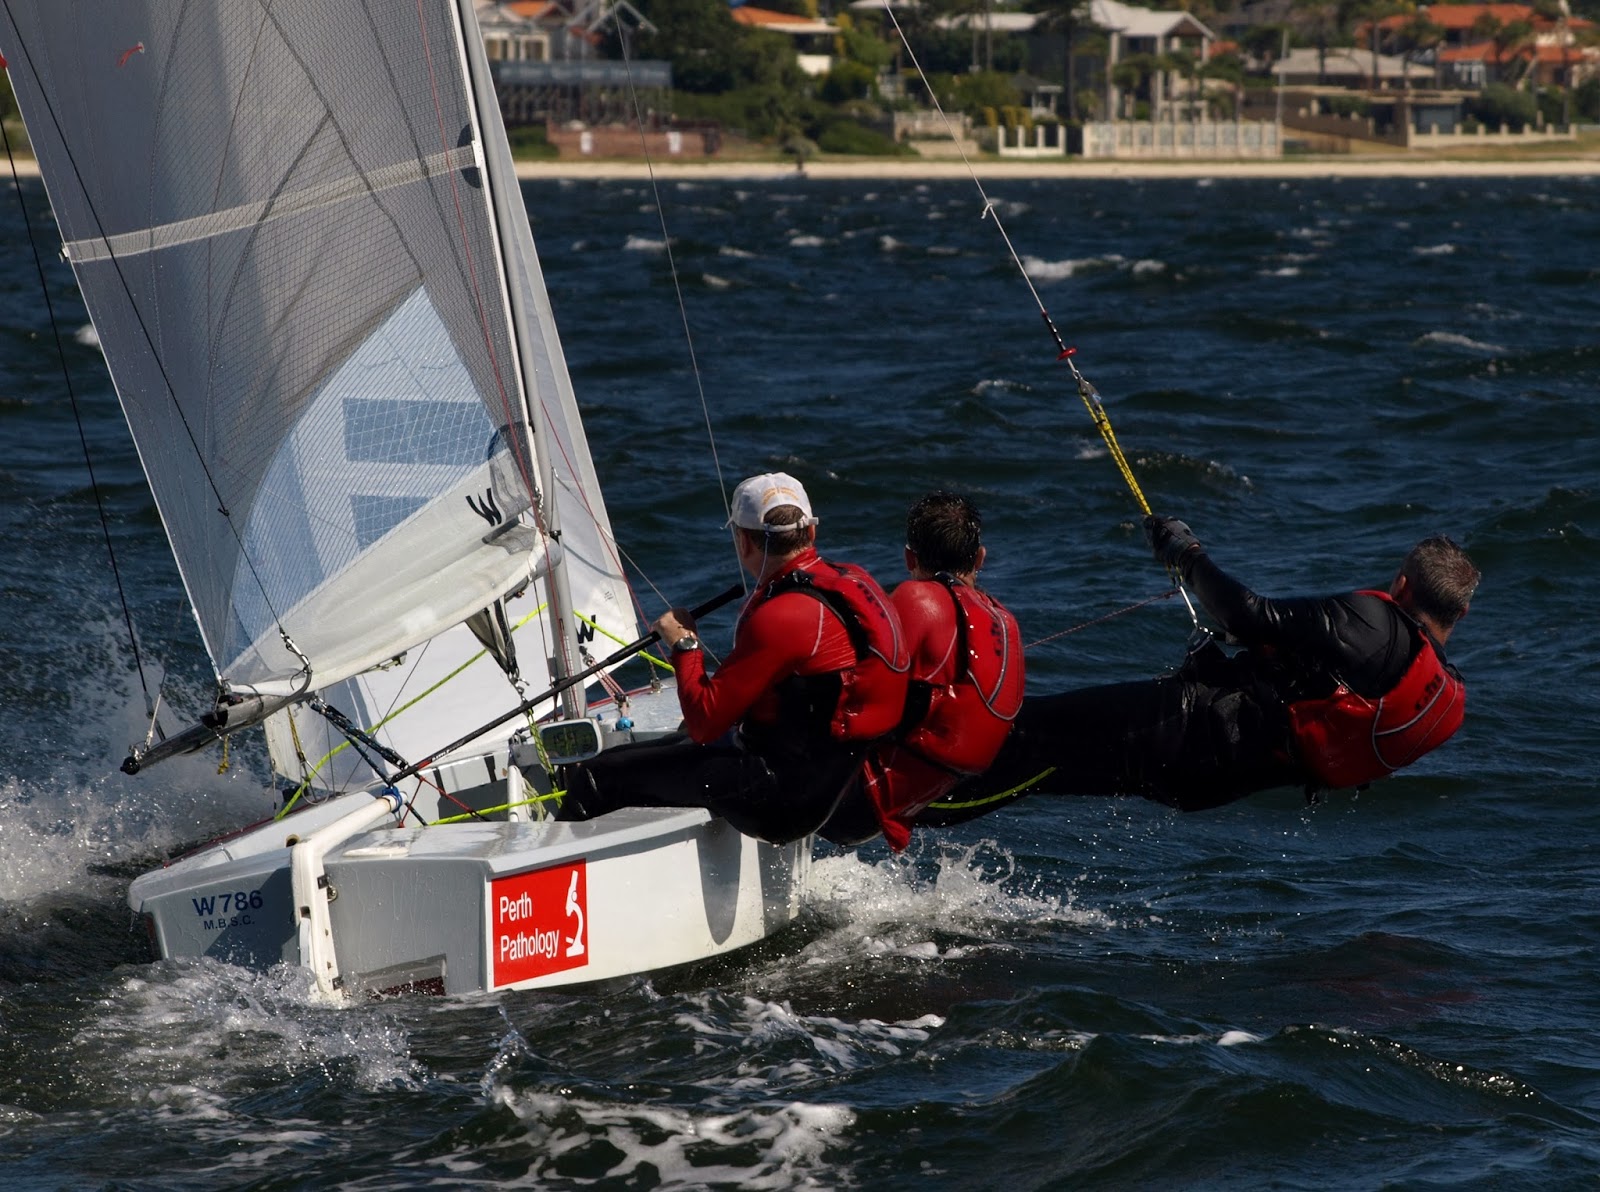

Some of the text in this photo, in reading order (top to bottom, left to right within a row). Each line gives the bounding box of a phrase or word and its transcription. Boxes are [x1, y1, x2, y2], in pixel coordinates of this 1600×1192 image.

[465, 487, 502, 527] W
[576, 614, 596, 644] W
[500, 891, 532, 924] Perth
[500, 927, 560, 963] Pathology
